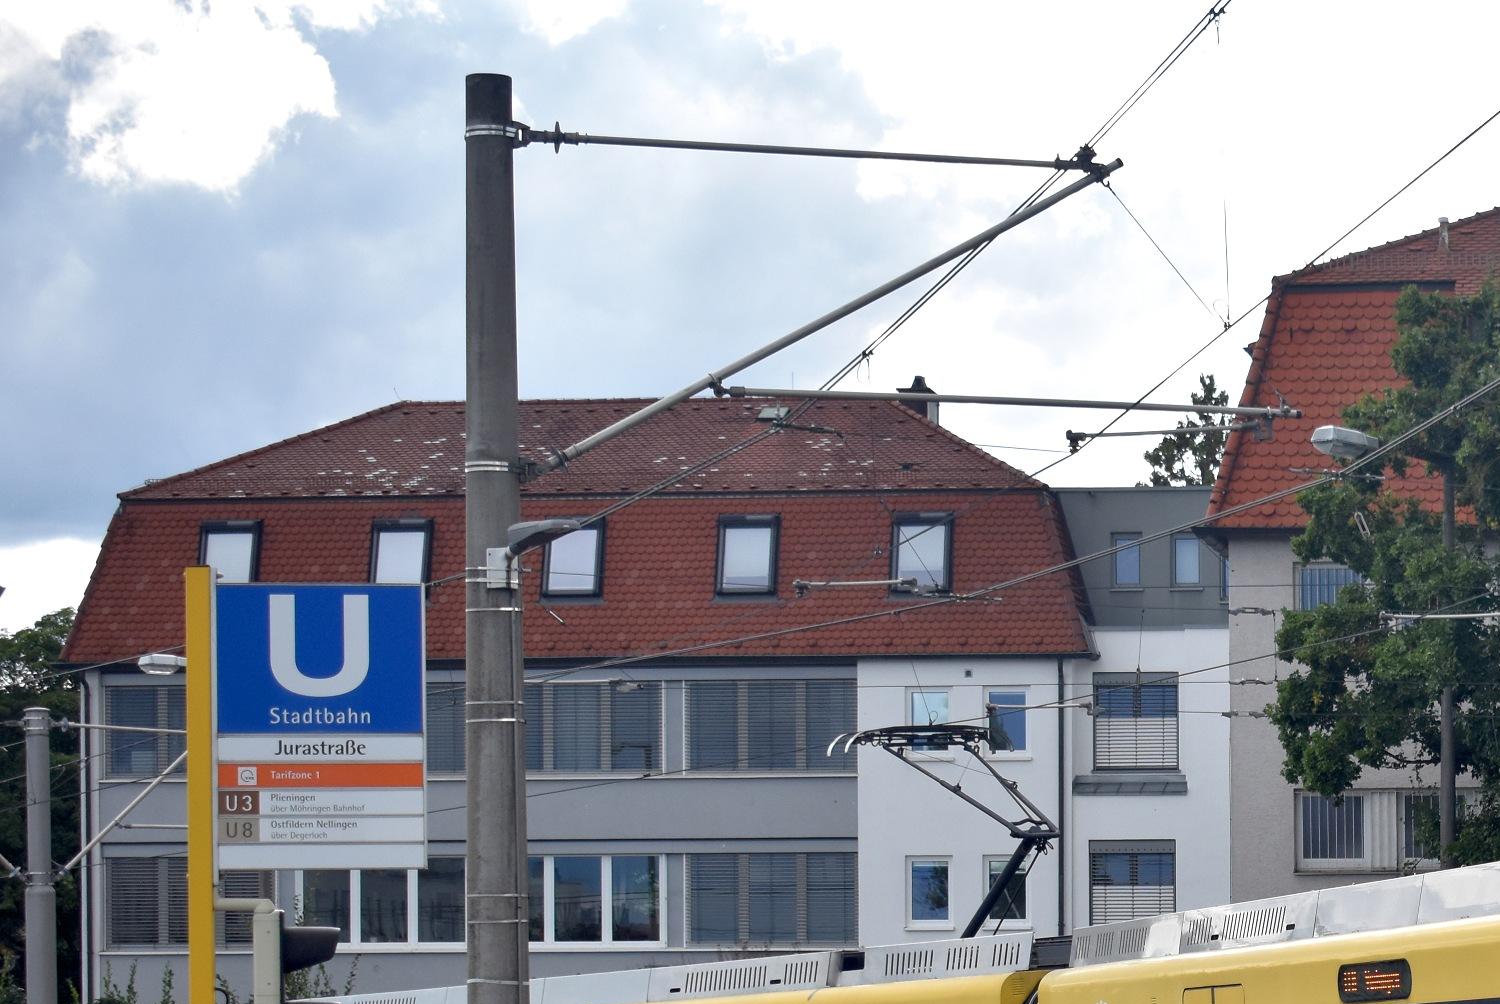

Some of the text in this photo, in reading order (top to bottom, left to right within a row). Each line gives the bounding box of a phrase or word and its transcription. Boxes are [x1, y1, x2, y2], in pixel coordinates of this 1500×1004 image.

[269, 594, 370, 697] U
[270, 707, 371, 724] Stadtbahn
[275, 739, 366, 756] Jurastraße
[271, 770, 320, 780] Tarifzone 1
[271, 793, 316, 803] Plieningen
[271, 804, 366, 814] über Möhringen Bahnhof
[271, 820, 358, 830] Ostfildern Nellingen
[271, 832, 328, 840] über Degerloch
